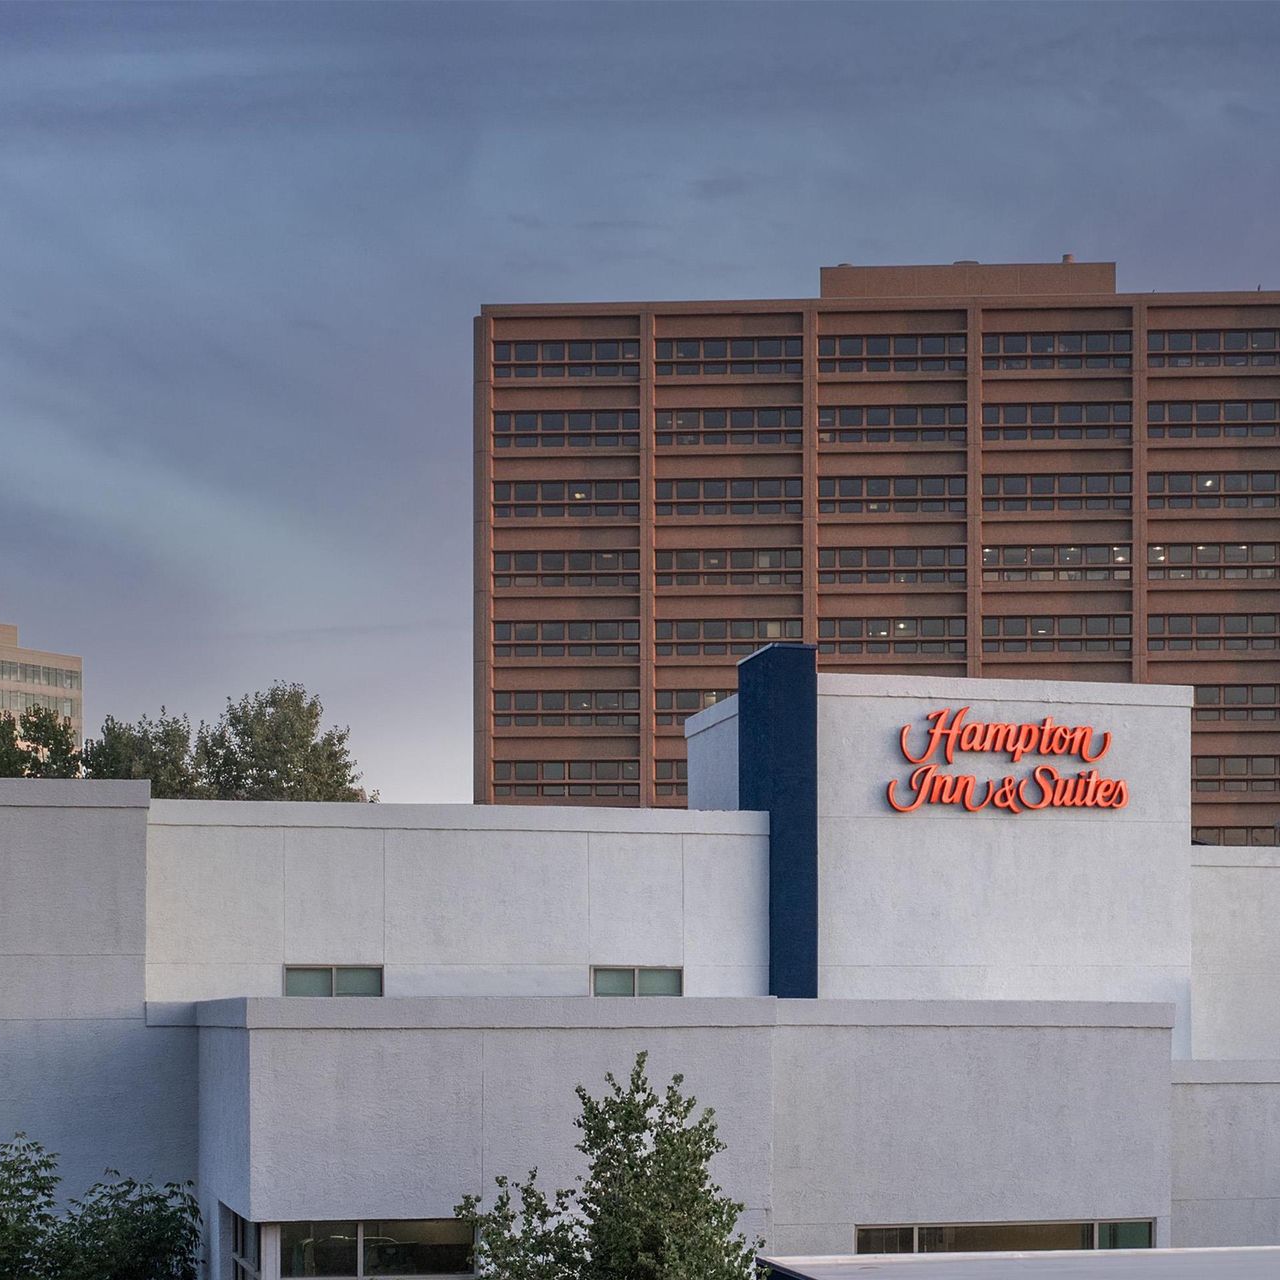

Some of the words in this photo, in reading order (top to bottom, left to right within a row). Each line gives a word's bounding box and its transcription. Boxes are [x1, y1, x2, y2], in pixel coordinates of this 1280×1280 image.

[900, 706, 1112, 764] Hampton
[888, 763, 994, 812] Inn
[993, 775, 1023, 814] &
[1018, 765, 1130, 811] Suites
